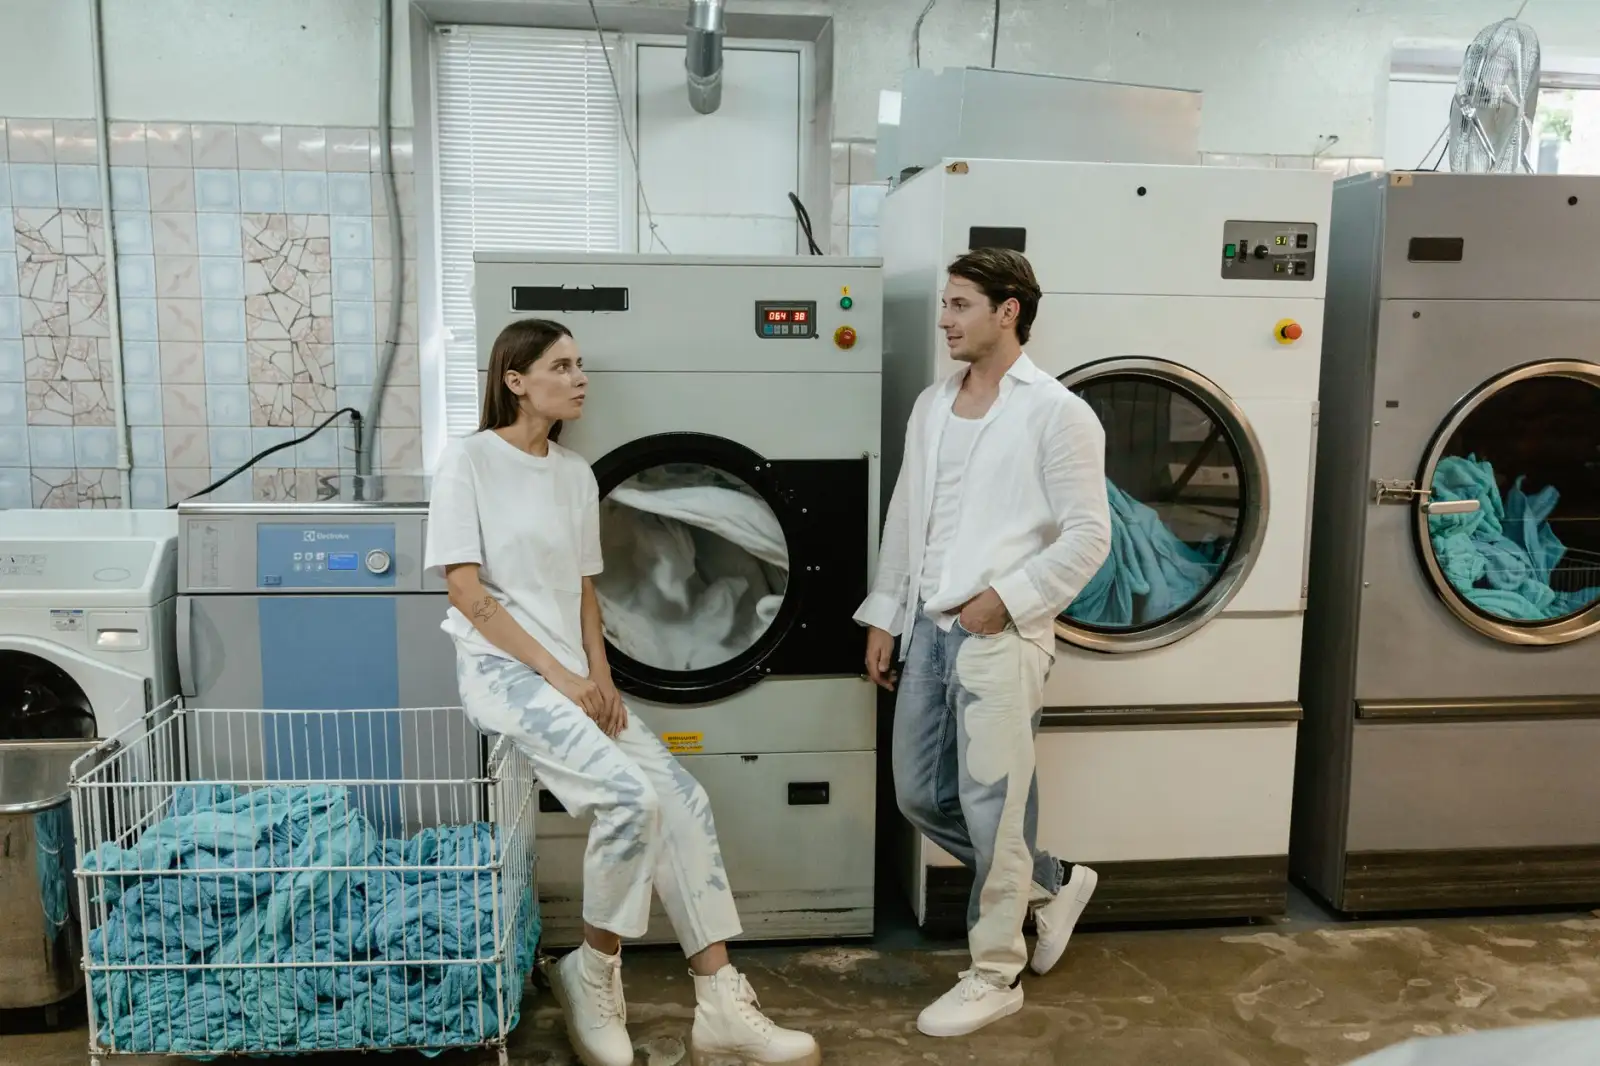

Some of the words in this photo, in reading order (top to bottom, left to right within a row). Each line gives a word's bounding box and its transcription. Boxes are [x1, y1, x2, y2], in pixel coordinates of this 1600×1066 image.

[951, 163, 958, 172] 6
[769, 311, 787, 321] 064
[794, 311, 805, 321] 38
[316, 532, 350, 540] Electrolux
